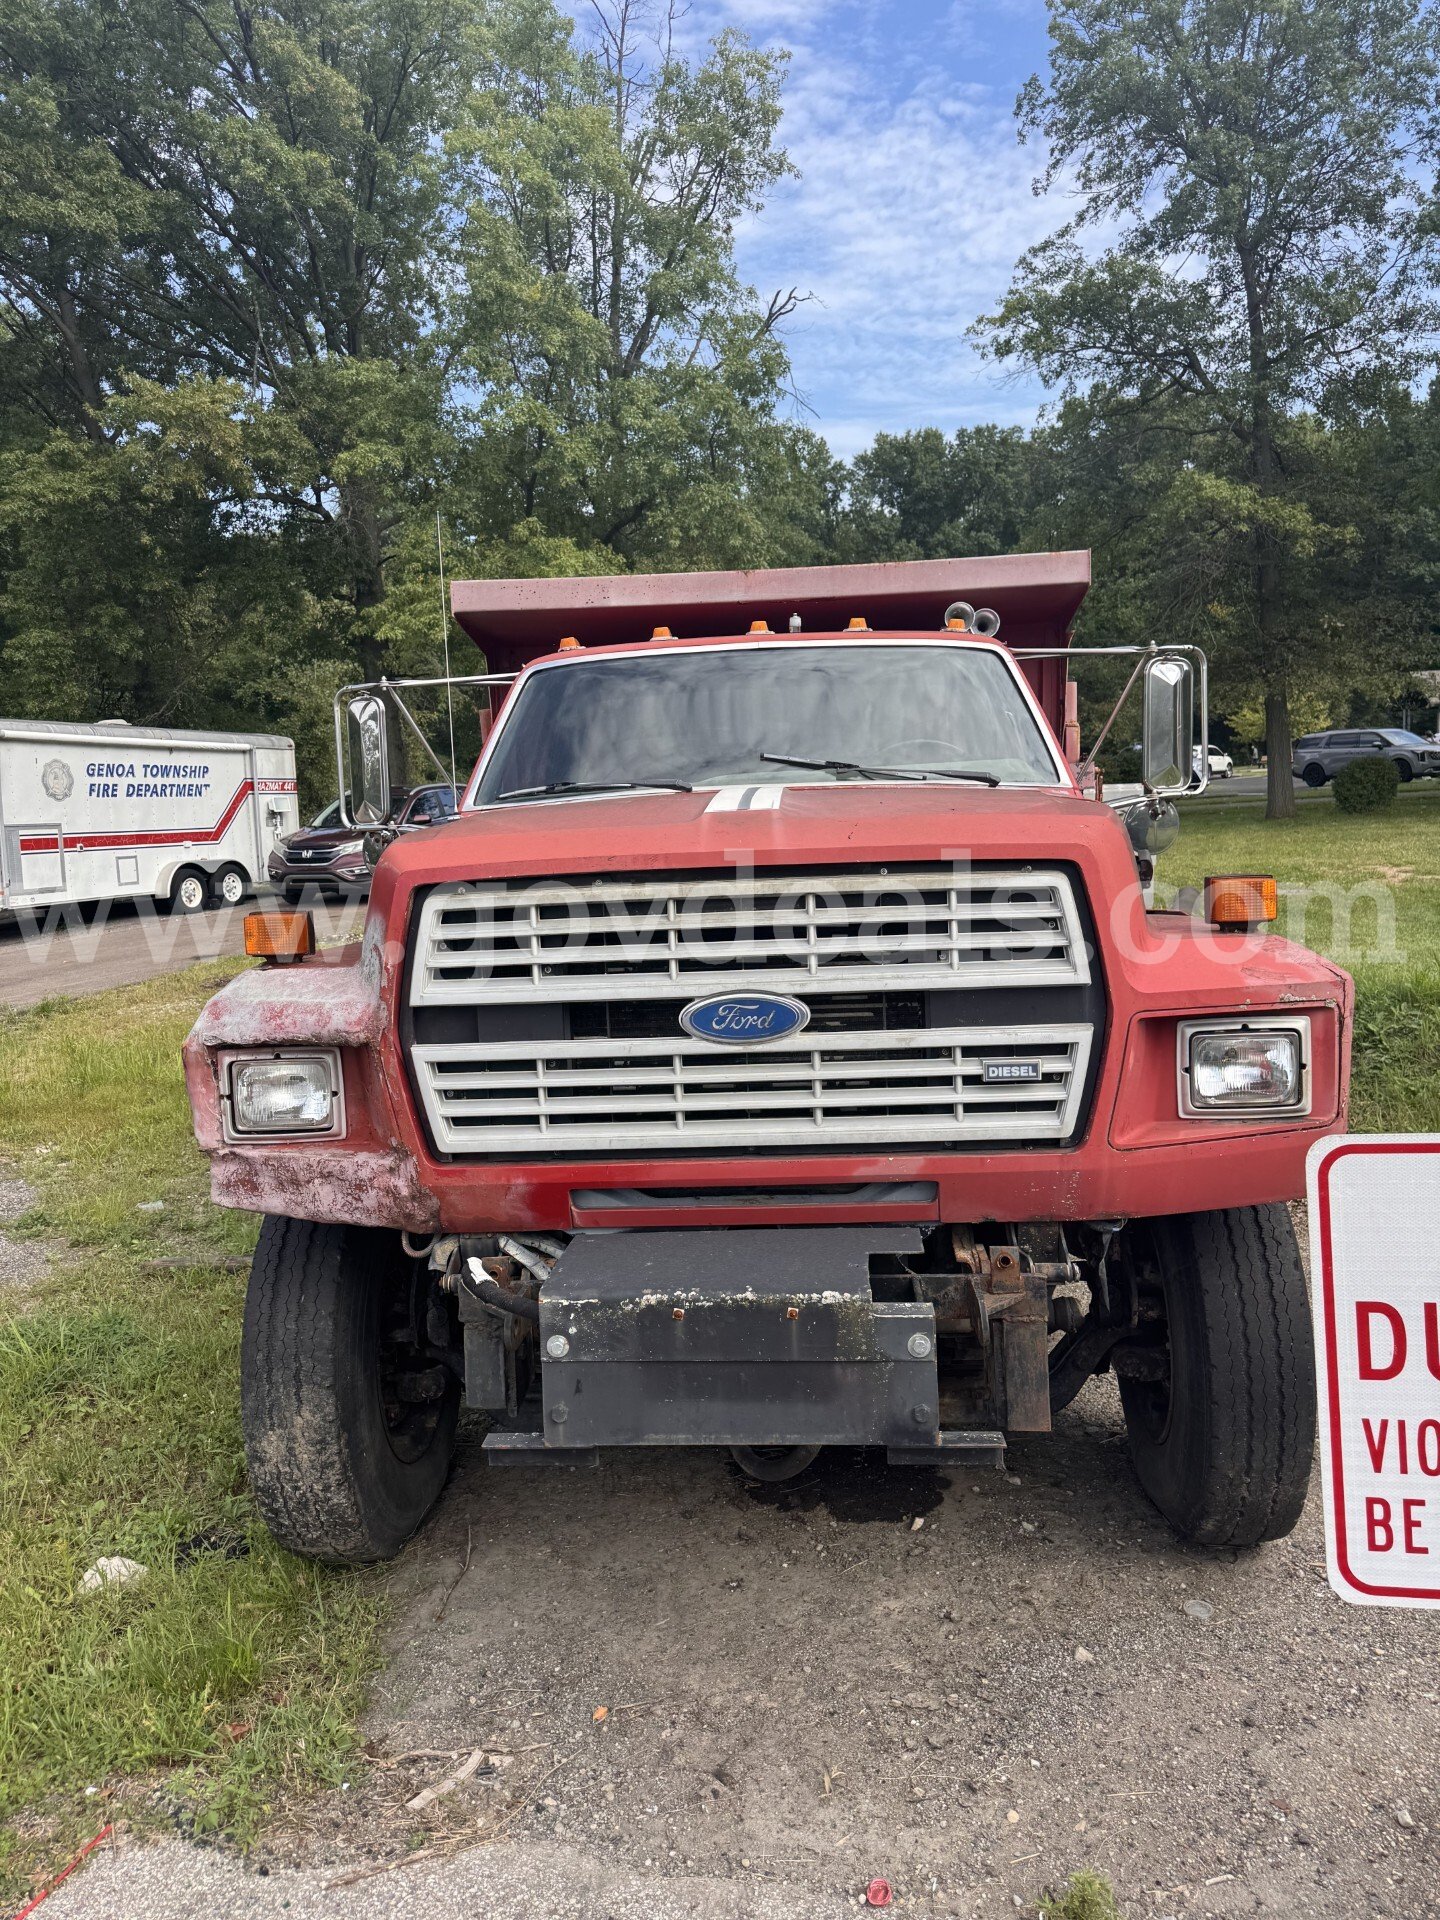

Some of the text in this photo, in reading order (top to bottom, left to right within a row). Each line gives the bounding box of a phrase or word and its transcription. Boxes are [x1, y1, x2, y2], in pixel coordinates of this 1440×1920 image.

[86, 763, 210, 779] GENOA TOWNSHIP
[88, 783, 211, 798] FIRE DEPARTMENT
[283, 782, 294, 791] 441
[712, 1003, 776, 1030] Ford
[988, 1066, 1037, 1077] DIESEL
[1365, 1496, 1429, 1555] BE
